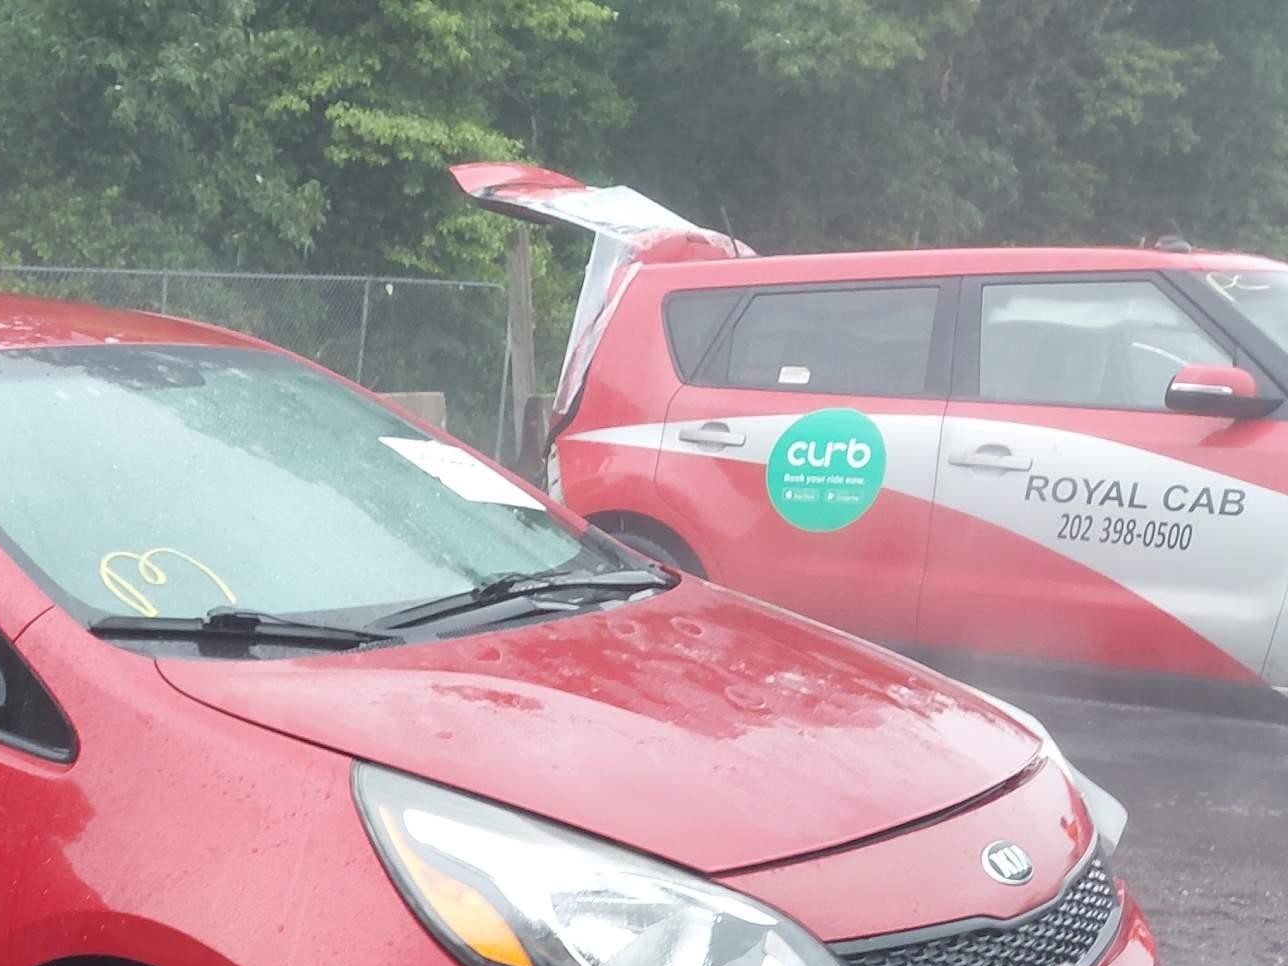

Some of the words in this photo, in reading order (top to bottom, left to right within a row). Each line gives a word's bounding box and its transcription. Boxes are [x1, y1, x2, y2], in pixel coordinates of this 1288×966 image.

[787, 438, 871, 468] curb
[1024, 475, 1148, 509] ROYAL
[1162, 484, 1247, 516] CAB
[1057, 513, 1093, 541] 202
[1099, 517, 1193, 550] 398-0500
